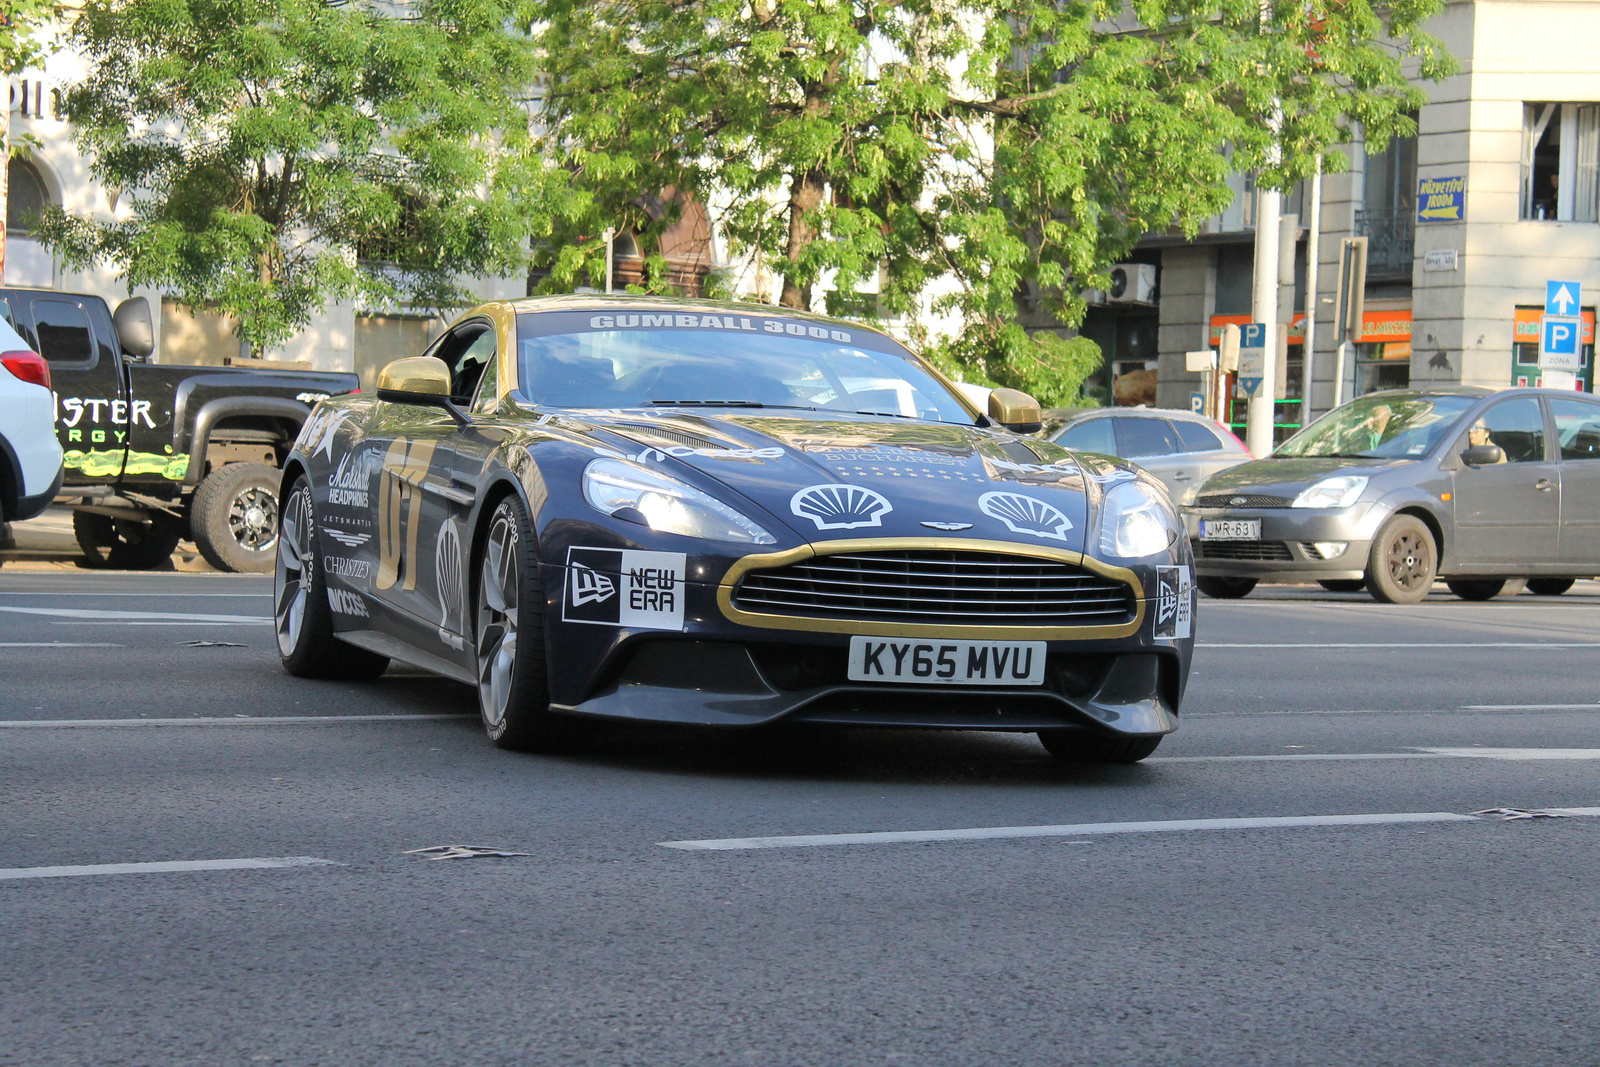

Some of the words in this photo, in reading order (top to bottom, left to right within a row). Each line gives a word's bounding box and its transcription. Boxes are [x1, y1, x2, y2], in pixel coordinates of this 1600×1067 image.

[1427, 194, 1454, 208] IRODA
[589, 314, 757, 331] GUMBALL
[763, 319, 851, 342] 3000
[1245, 324, 1260, 346] P
[1549, 325, 1570, 350] P
[1191, 396, 1203, 412] P
[55, 429, 126, 443] RGY
[328, 452, 372, 490] Marshall
[822, 453, 968, 467] BUCHAREST
[328, 488, 369, 509] HEADPHONES
[307, 551, 315, 594] 3000
[629, 567, 675, 590] NEW
[629, 589, 675, 613] ERA
[862, 642, 957, 678] KY65
[966, 646, 1033, 679] MVU
